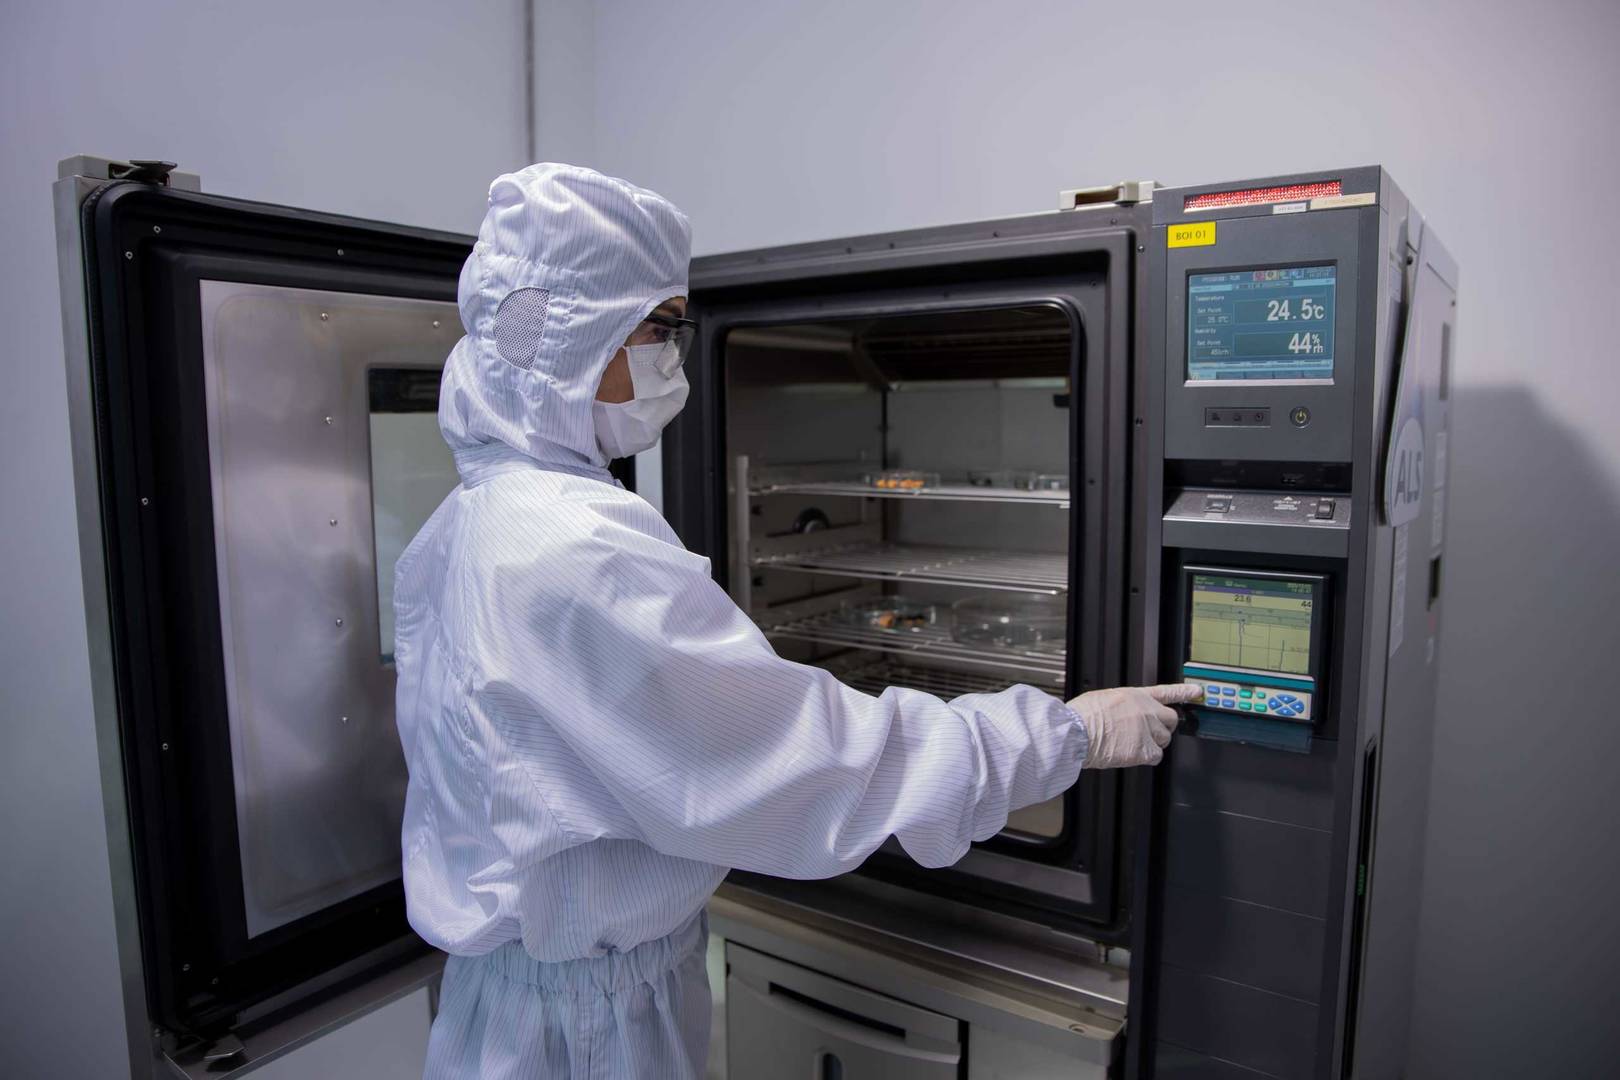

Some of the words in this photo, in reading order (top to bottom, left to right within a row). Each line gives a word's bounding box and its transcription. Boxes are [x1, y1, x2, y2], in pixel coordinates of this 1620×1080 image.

[1175, 231, 1193, 241] BOI
[1195, 229, 1206, 240] 01
[1394, 450, 1422, 508] ALS
